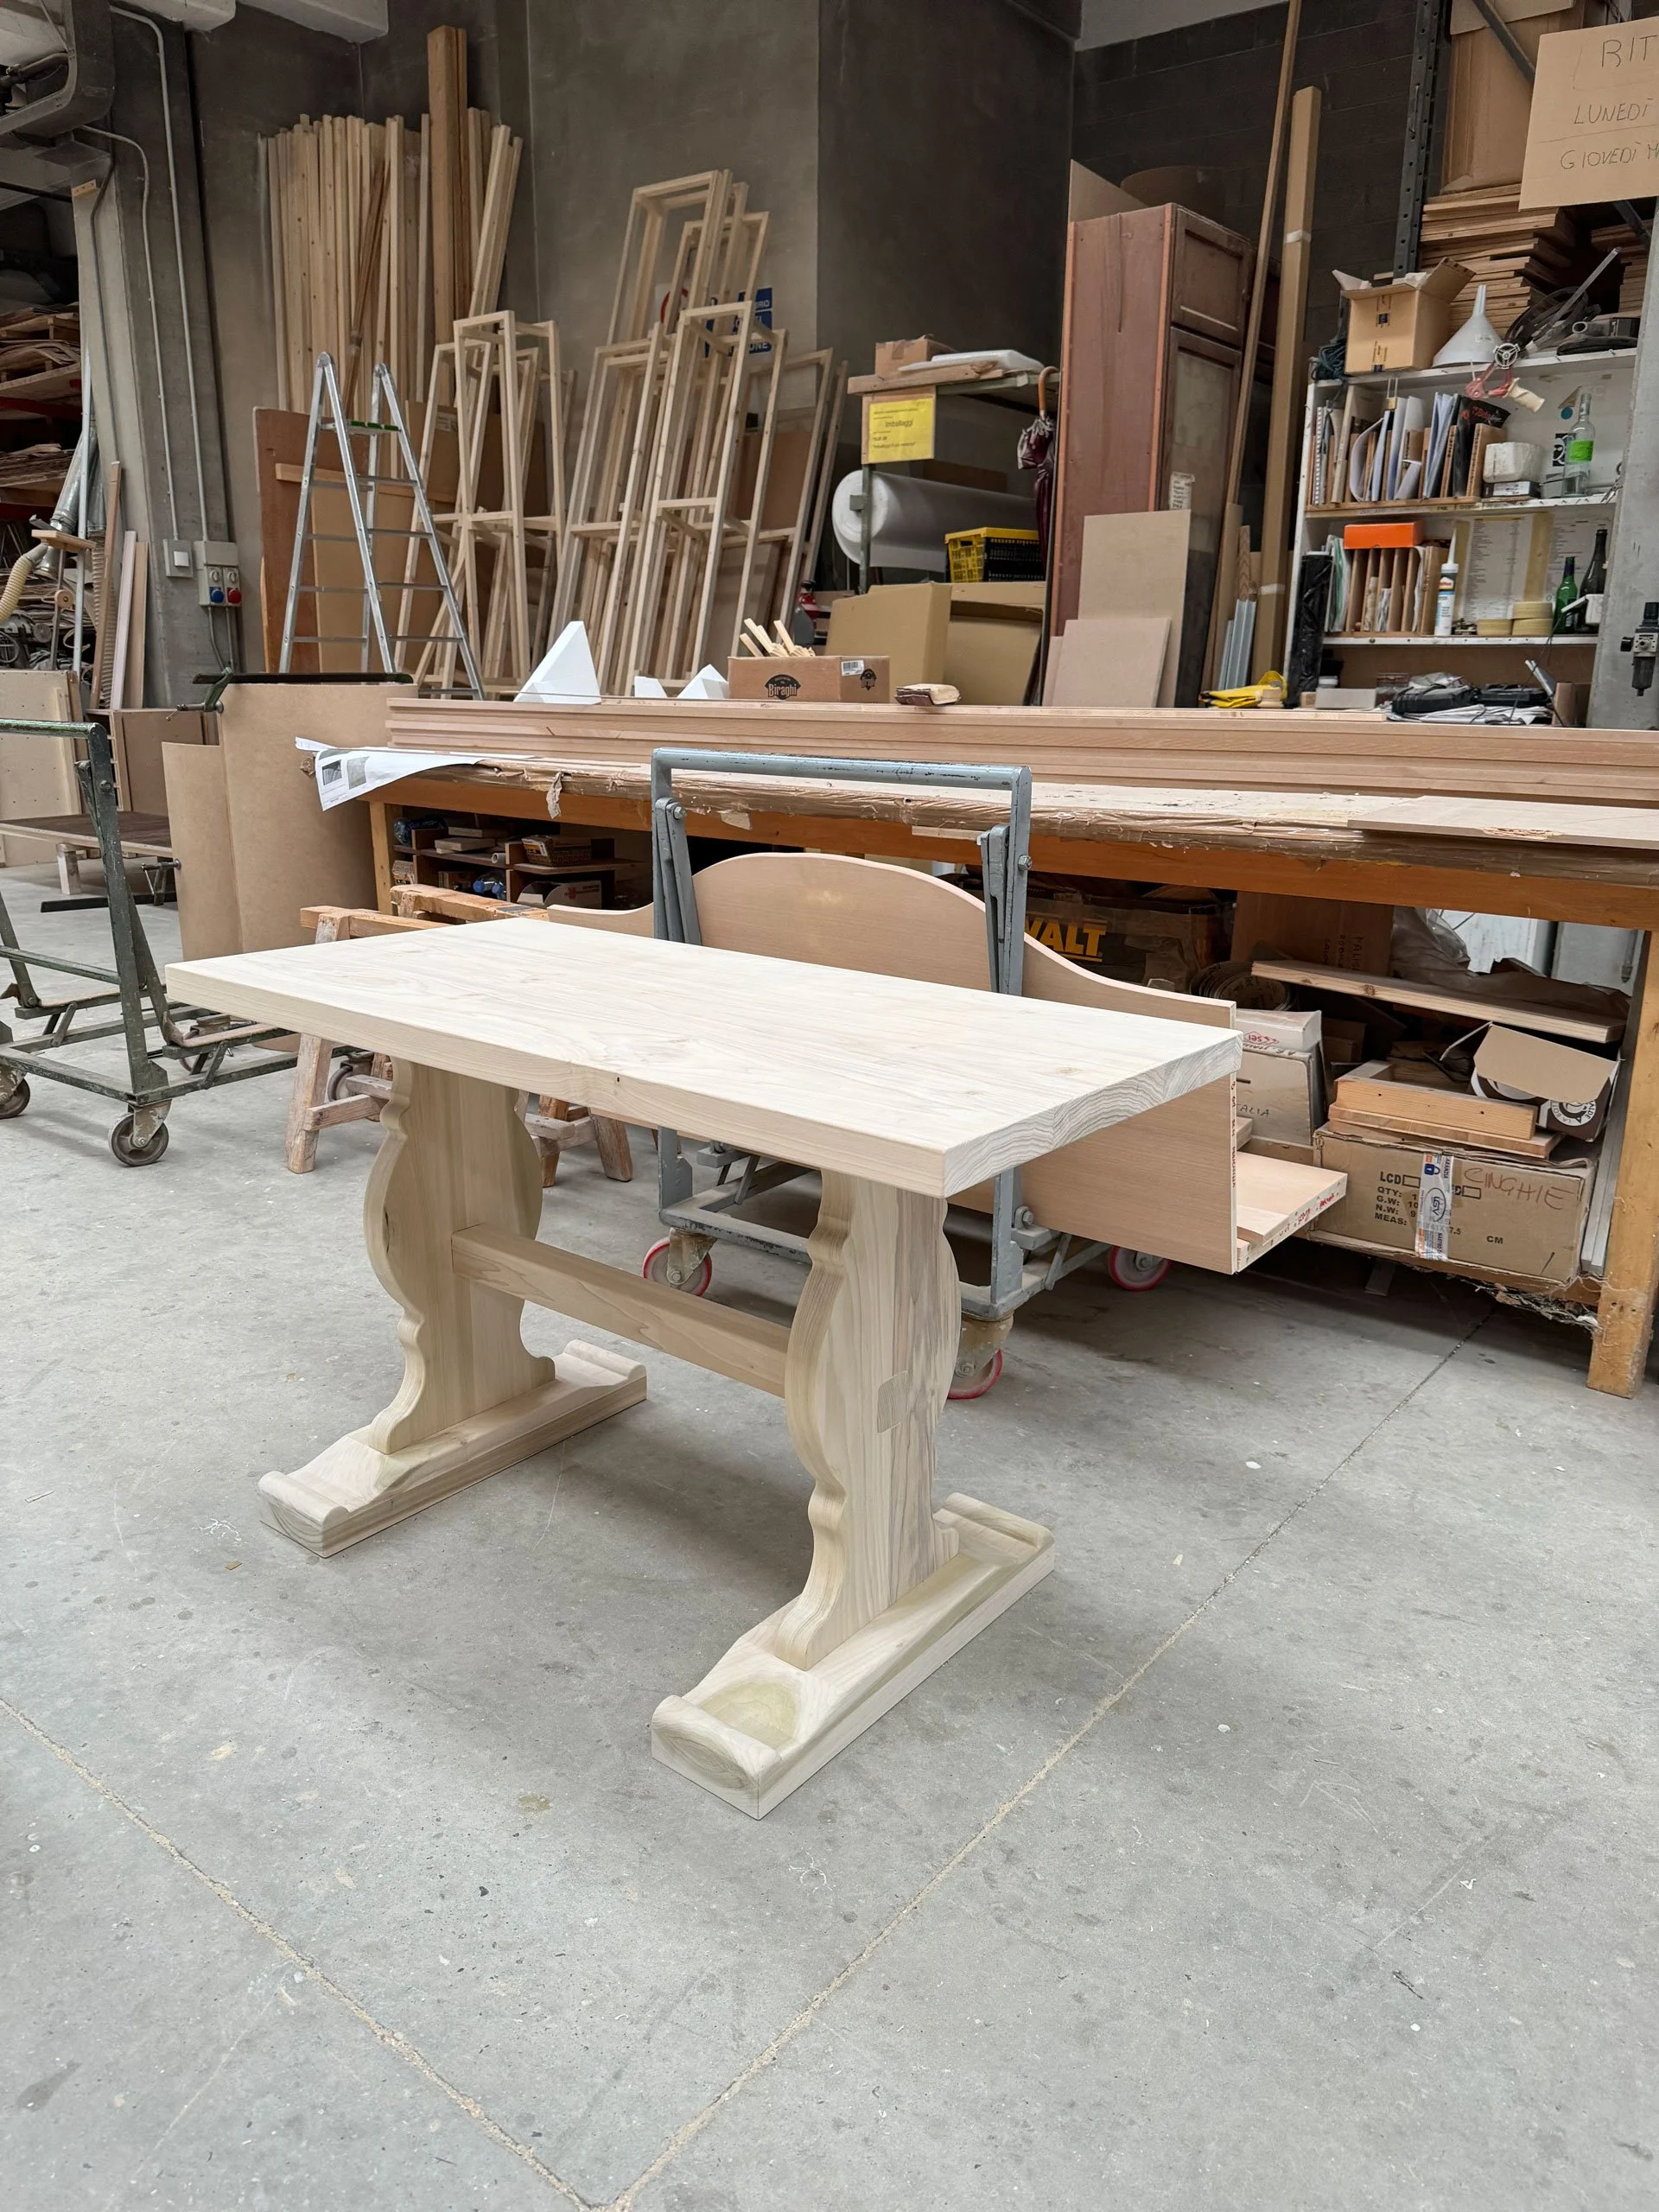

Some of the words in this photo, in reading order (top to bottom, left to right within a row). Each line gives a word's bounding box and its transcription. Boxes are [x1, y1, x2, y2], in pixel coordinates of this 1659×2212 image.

[1573, 98, 1654, 124] LUNEDÌ
[1560, 141, 1641, 170] GIOVEDÌ
[768, 683, 798, 697] Biraghi
[1380, 1171, 1402, 1185] LCD
[1377, 1186, 1402, 1198] QTY:
[1464, 1167, 1574, 1210] CINGHIE
[1376, 1195, 1400, 1206] G.W:
[1376, 1204, 1399, 1215] N.W:
[1375, 1212, 1408, 1226] MEAS:
[1486, 1236, 1503, 1244] CM
